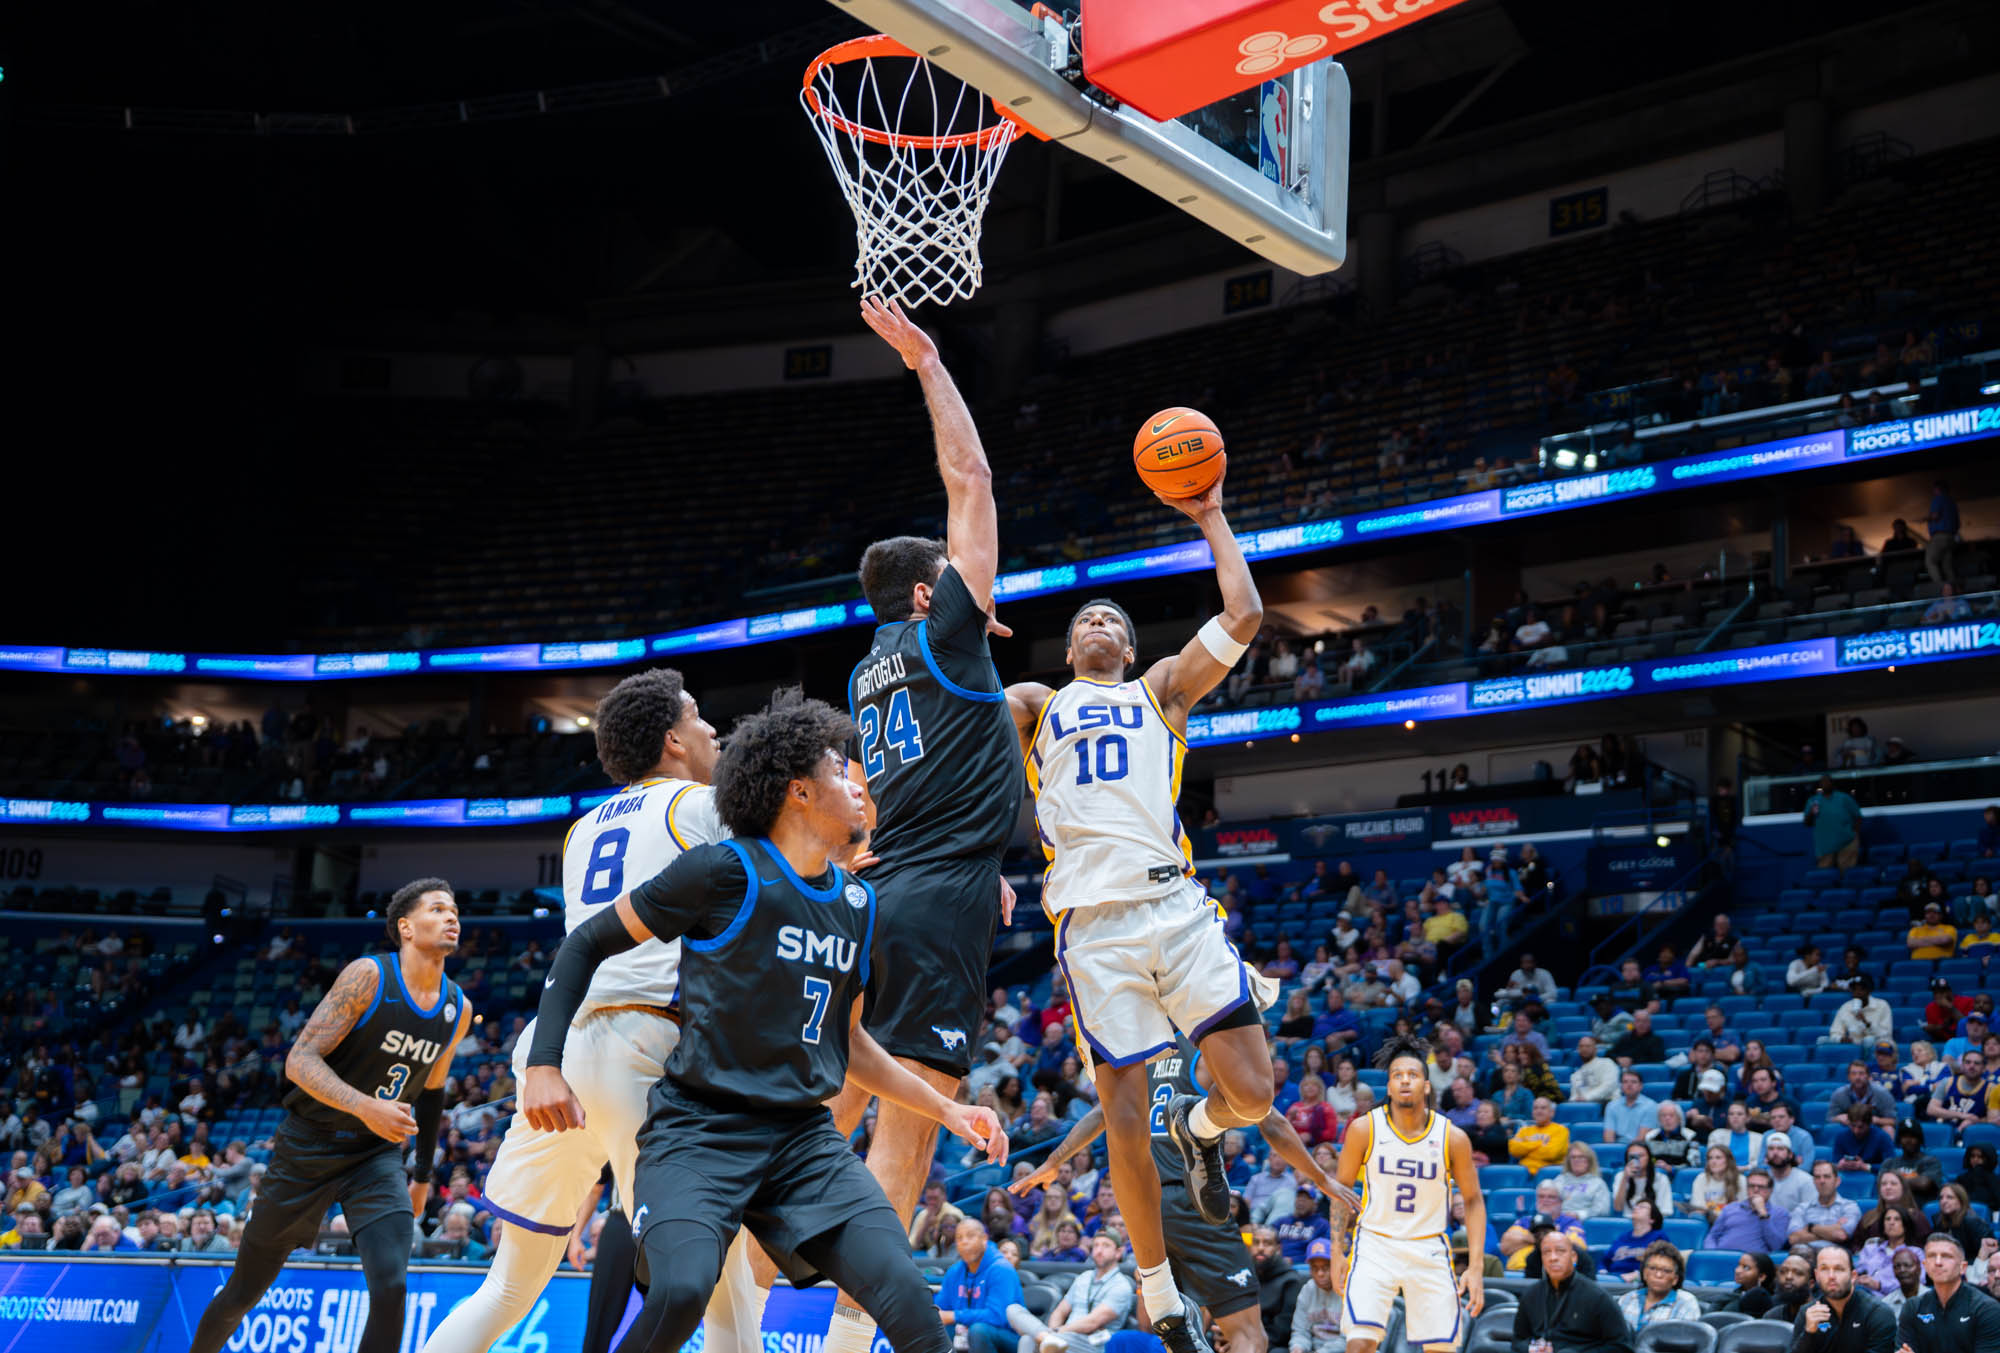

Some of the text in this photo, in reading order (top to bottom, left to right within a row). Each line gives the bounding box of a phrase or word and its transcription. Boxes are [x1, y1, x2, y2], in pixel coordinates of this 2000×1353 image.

[1556, 195, 1602, 228] 315
[1156, 437, 1204, 460] ELITE
[1853, 430, 1911, 451] HOOPS
[1506, 492, 1554, 510] HOOPS
[1845, 642, 1907, 662] HOOPS
[1473, 687, 1525, 705] HOOPS
[858, 686, 925, 781] 24
[1050, 705, 1143, 741] LSU
[1074, 734, 1129, 786] 10
[595, 792, 648, 825] TAMBA
[581, 827, 631, 905] 8
[776, 924, 857, 973] SMU
[802, 976, 832, 1045] 7
[380, 1029, 441, 1064] SMU
[375, 1063, 411, 1101] 3
[1153, 1058, 1183, 1078] MILLER
[1149, 1083, 1175, 1136] 2
[1379, 1155, 1437, 1180] LSU
[1395, 1183, 1416, 1213] 2
[227, 1313, 309, 1353] OOPS
